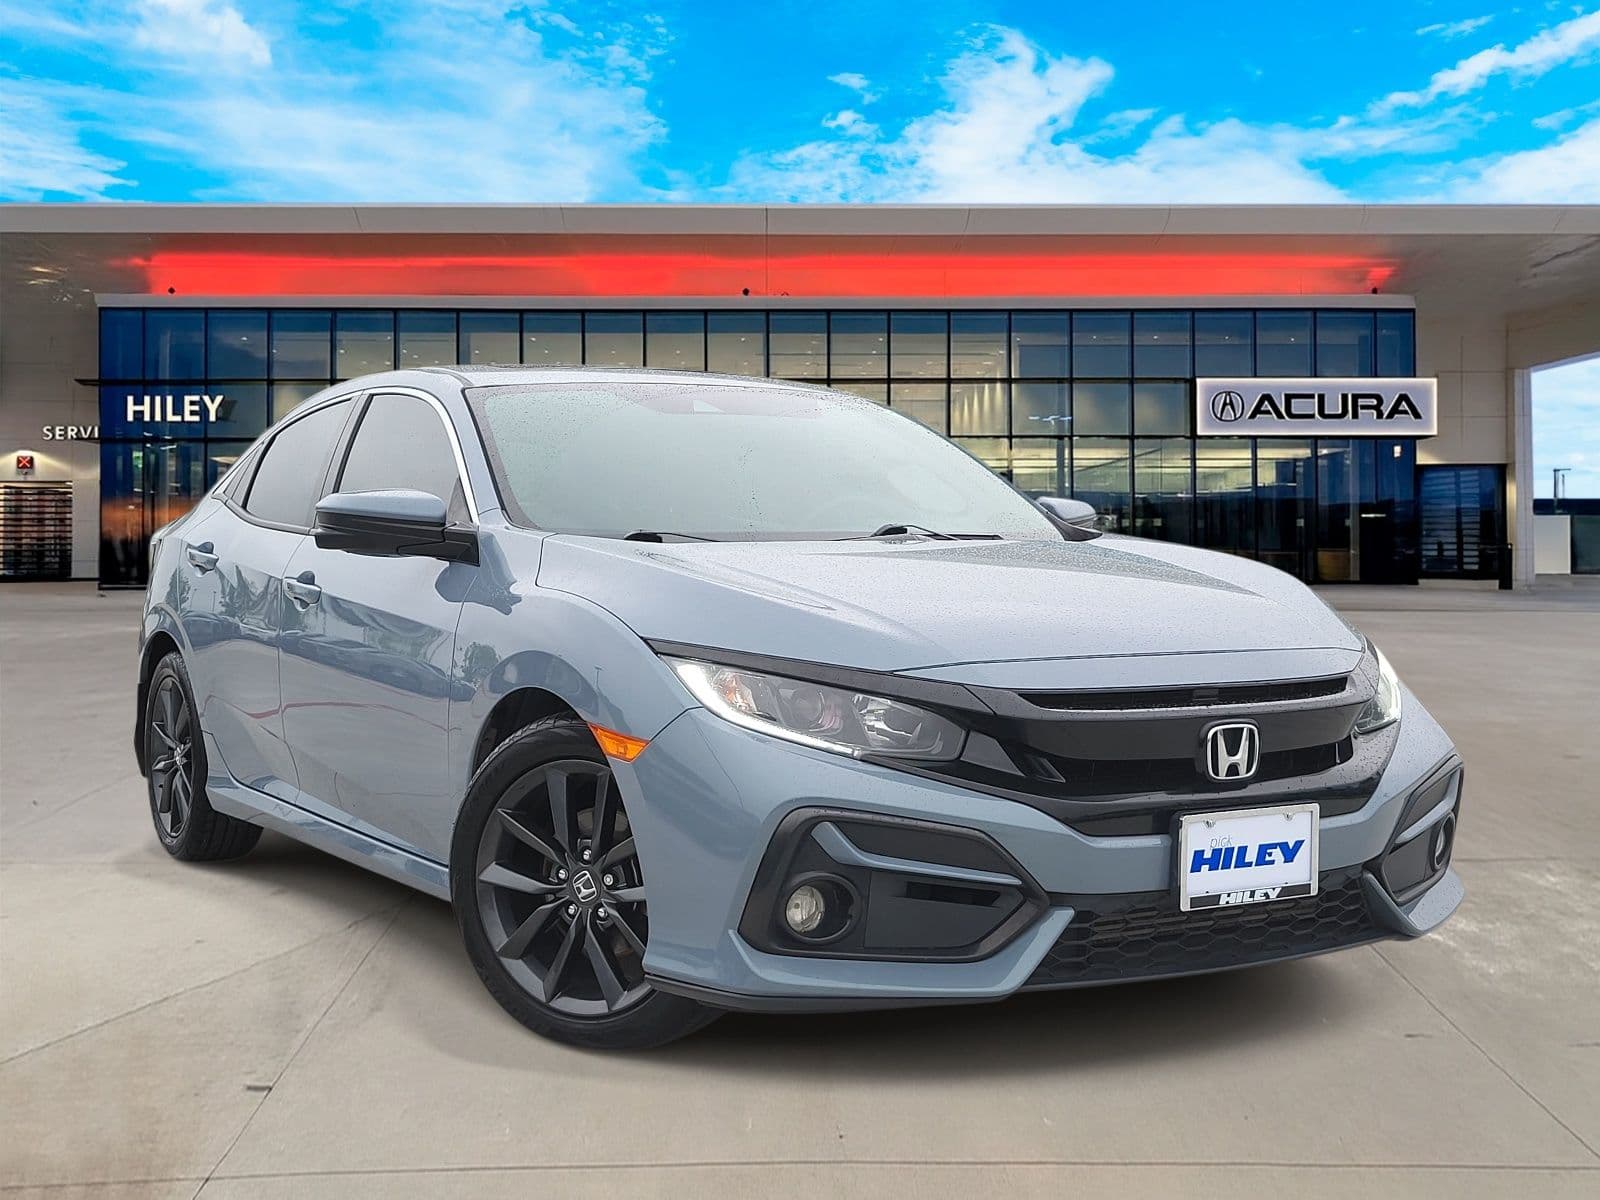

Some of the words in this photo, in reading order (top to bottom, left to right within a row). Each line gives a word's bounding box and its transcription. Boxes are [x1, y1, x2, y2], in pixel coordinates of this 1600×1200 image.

[126, 394, 225, 422] HILEY
[1247, 392, 1424, 420] ACURA
[1189, 839, 1306, 873] HILEY
[1219, 887, 1282, 905] HILEY
